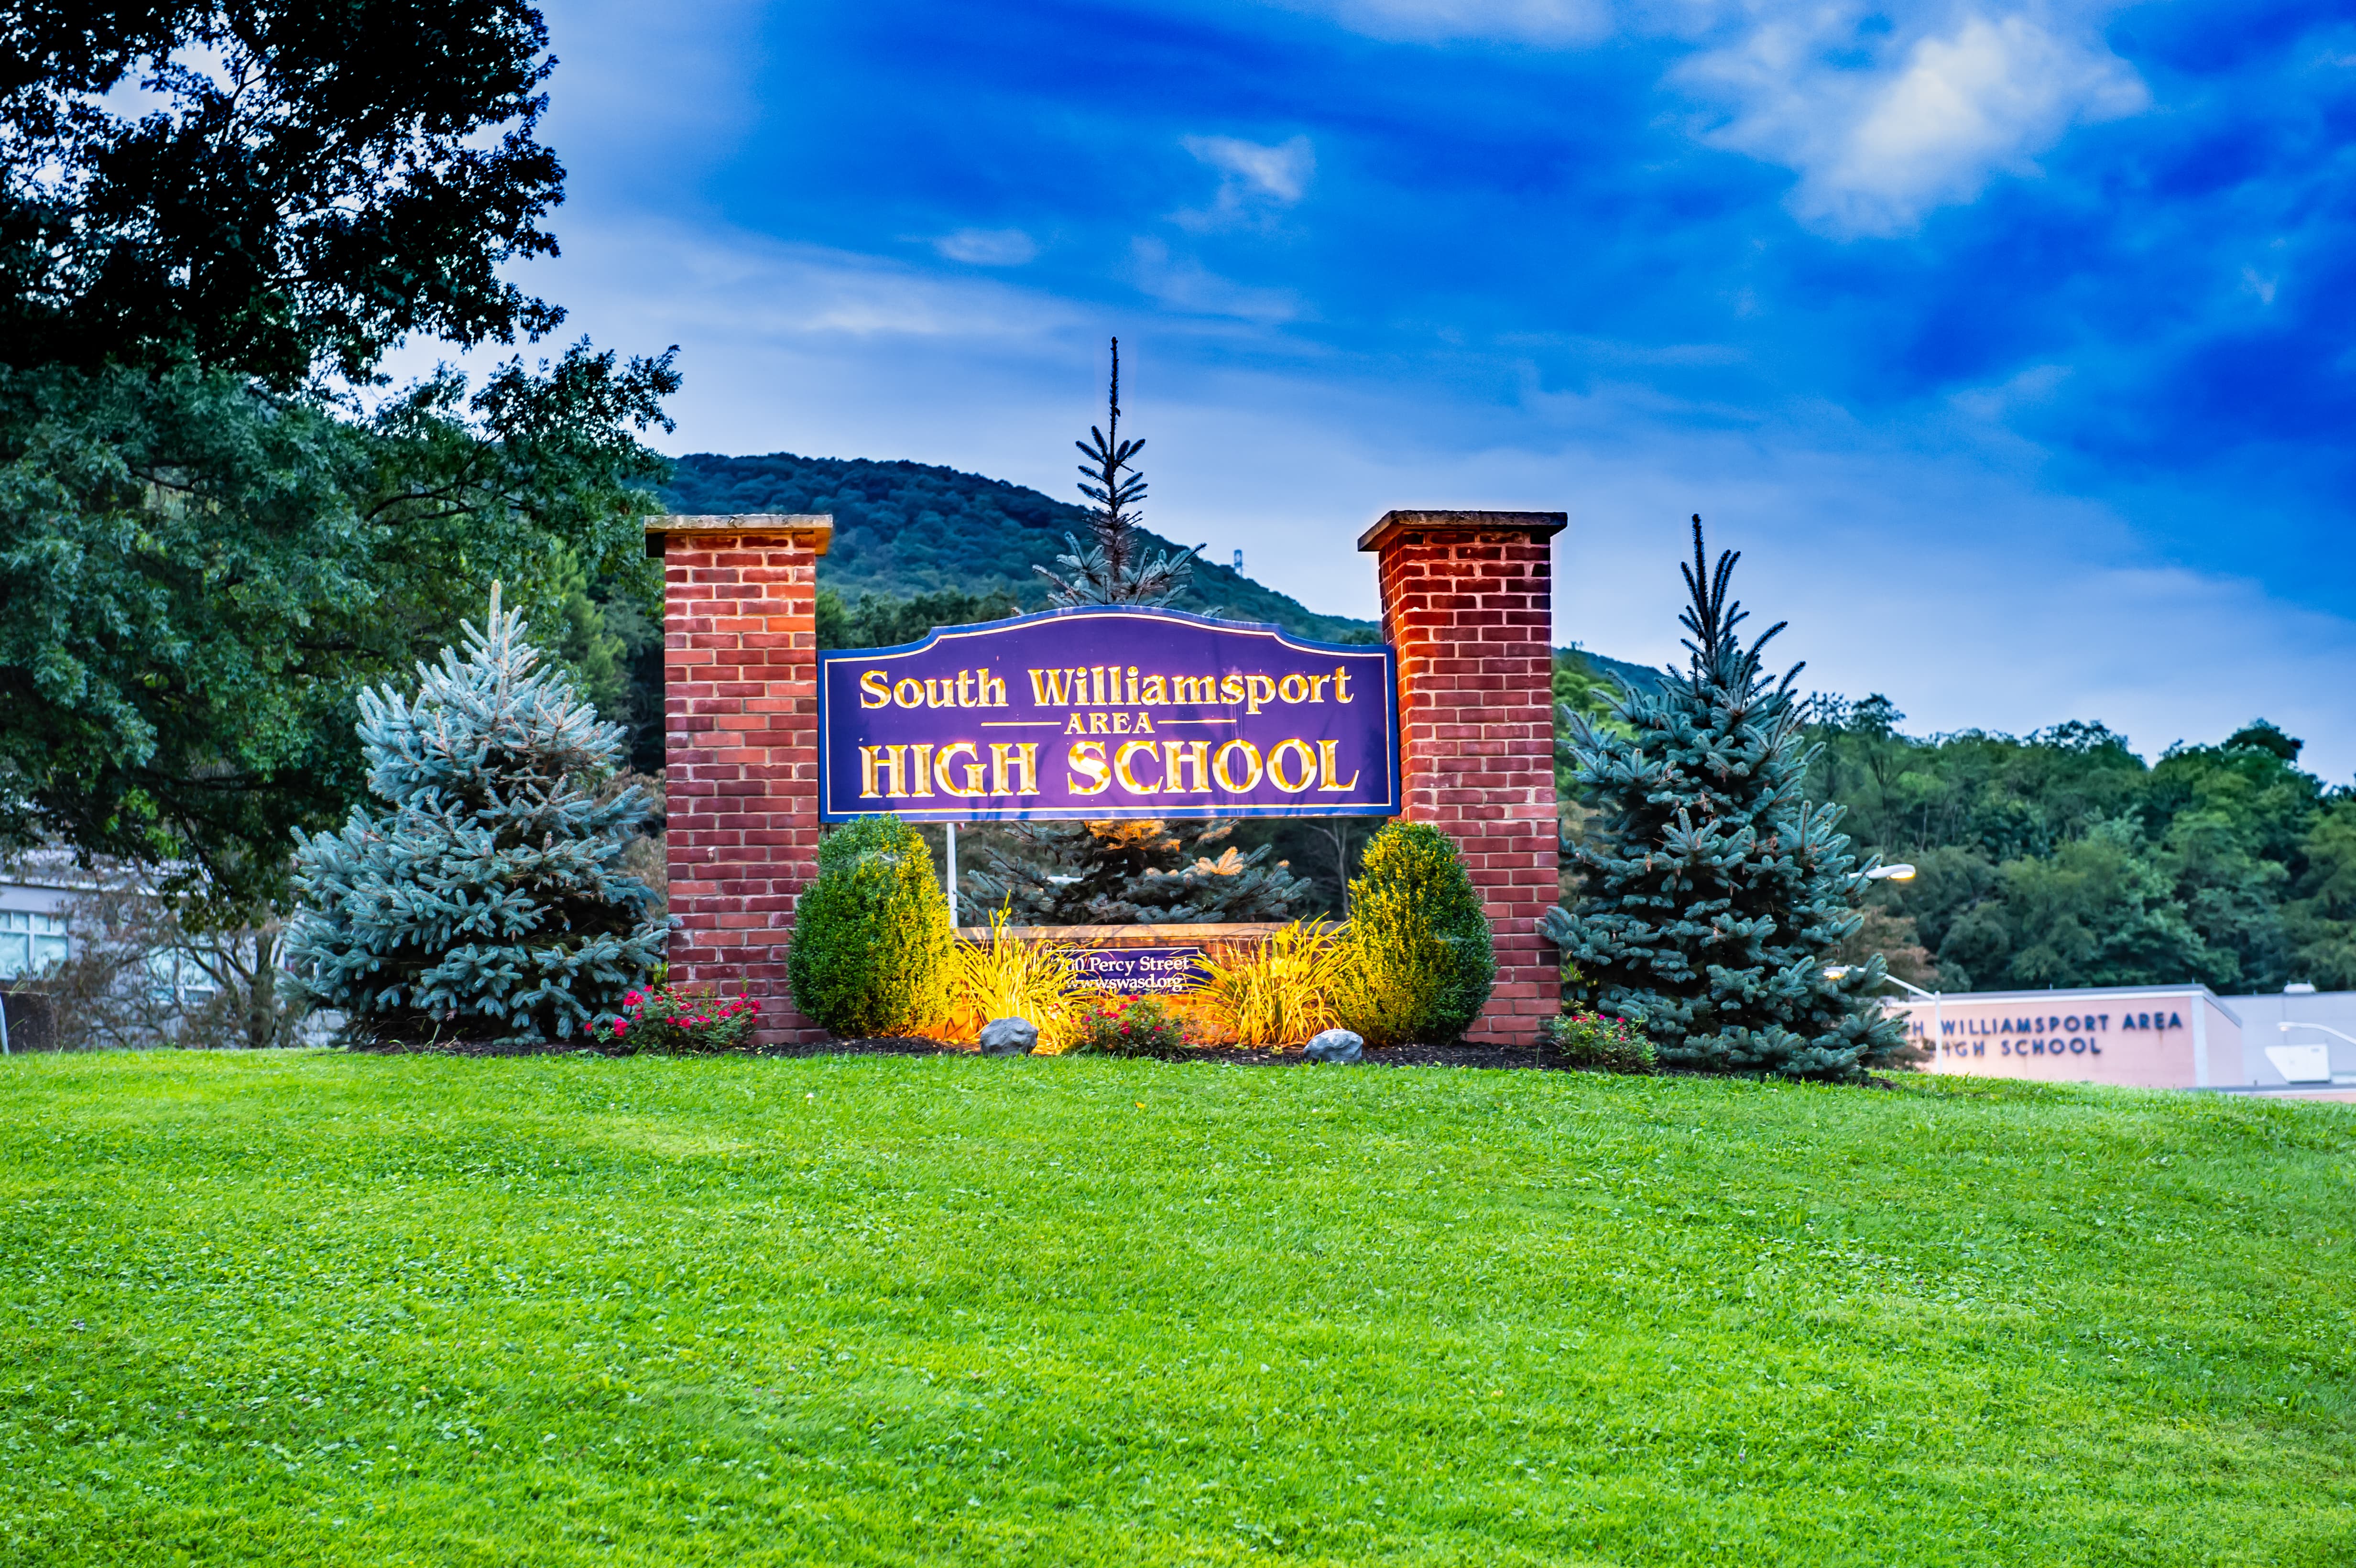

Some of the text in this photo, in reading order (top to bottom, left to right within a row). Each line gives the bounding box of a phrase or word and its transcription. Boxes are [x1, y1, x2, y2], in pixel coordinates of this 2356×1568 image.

[860, 665, 1355, 715] South Williamsport
[1064, 712, 1156, 735] AREA
[858, 739, 1360, 798] HIGH SCHOOL
[1089, 958, 1135, 976] Percy
[1140, 956, 1189, 971] Street
[1941, 1014, 2109, 1036] WILLIAMSPORT
[2122, 1011, 2183, 1031] AREA
[1929, 1037, 2102, 1057] IGH SCHOOL
